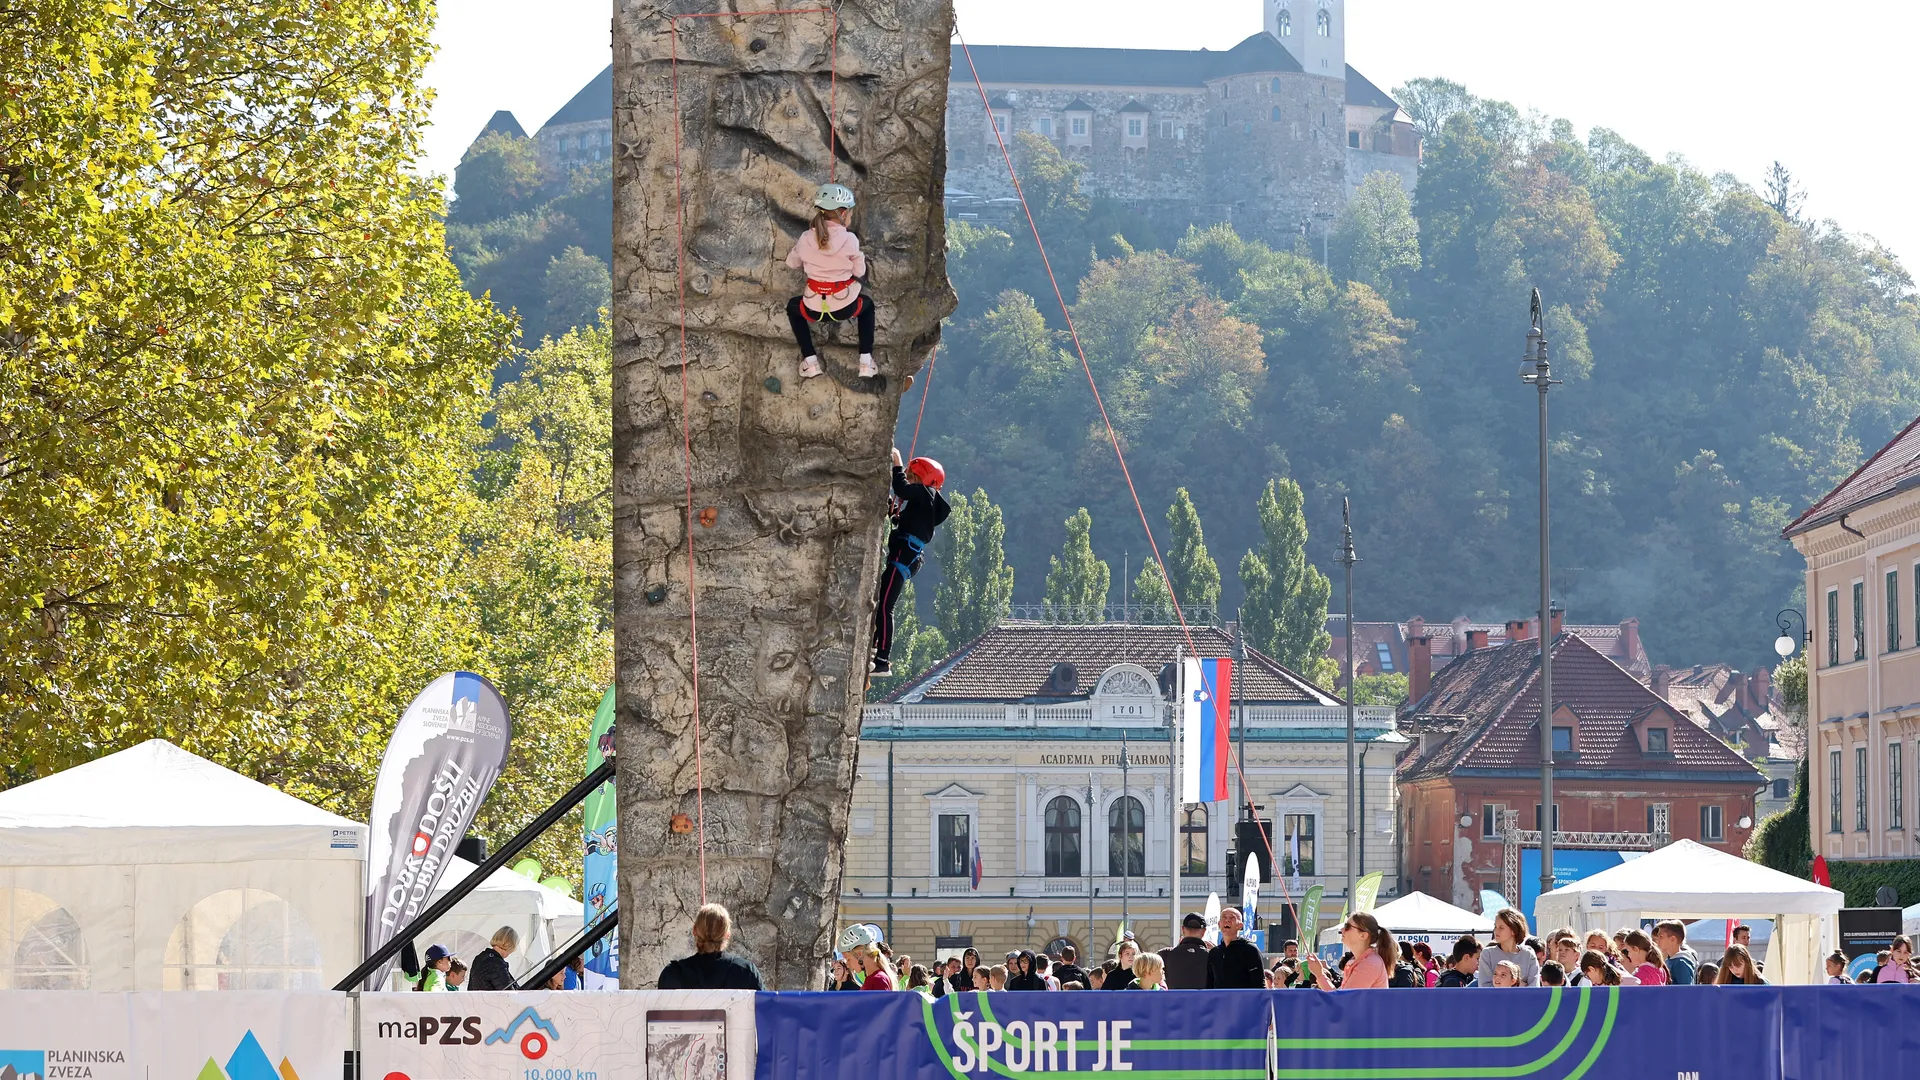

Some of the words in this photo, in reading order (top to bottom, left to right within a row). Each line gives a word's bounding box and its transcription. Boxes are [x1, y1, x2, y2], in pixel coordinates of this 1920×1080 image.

[1112, 706, 1142, 714] 1701
[447, 735, 474, 743] www.pzs.si
[1040, 755, 1094, 764] ACADEMIA
[433, 776, 480, 852] DRUŽBI!
[1398, 935, 1430, 943] ALPSKO
[378, 1016, 482, 1045] maPZS
[952, 1011, 1084, 1072] ŠPORT
[1092, 1020, 1133, 1071] JE
[48, 1050, 125, 1063] PLANINSKA
[49, 1066, 92, 1078] ZVEZA
[577, 1069, 597, 1080] km
[1678, 1071, 1699, 1080] DAN
